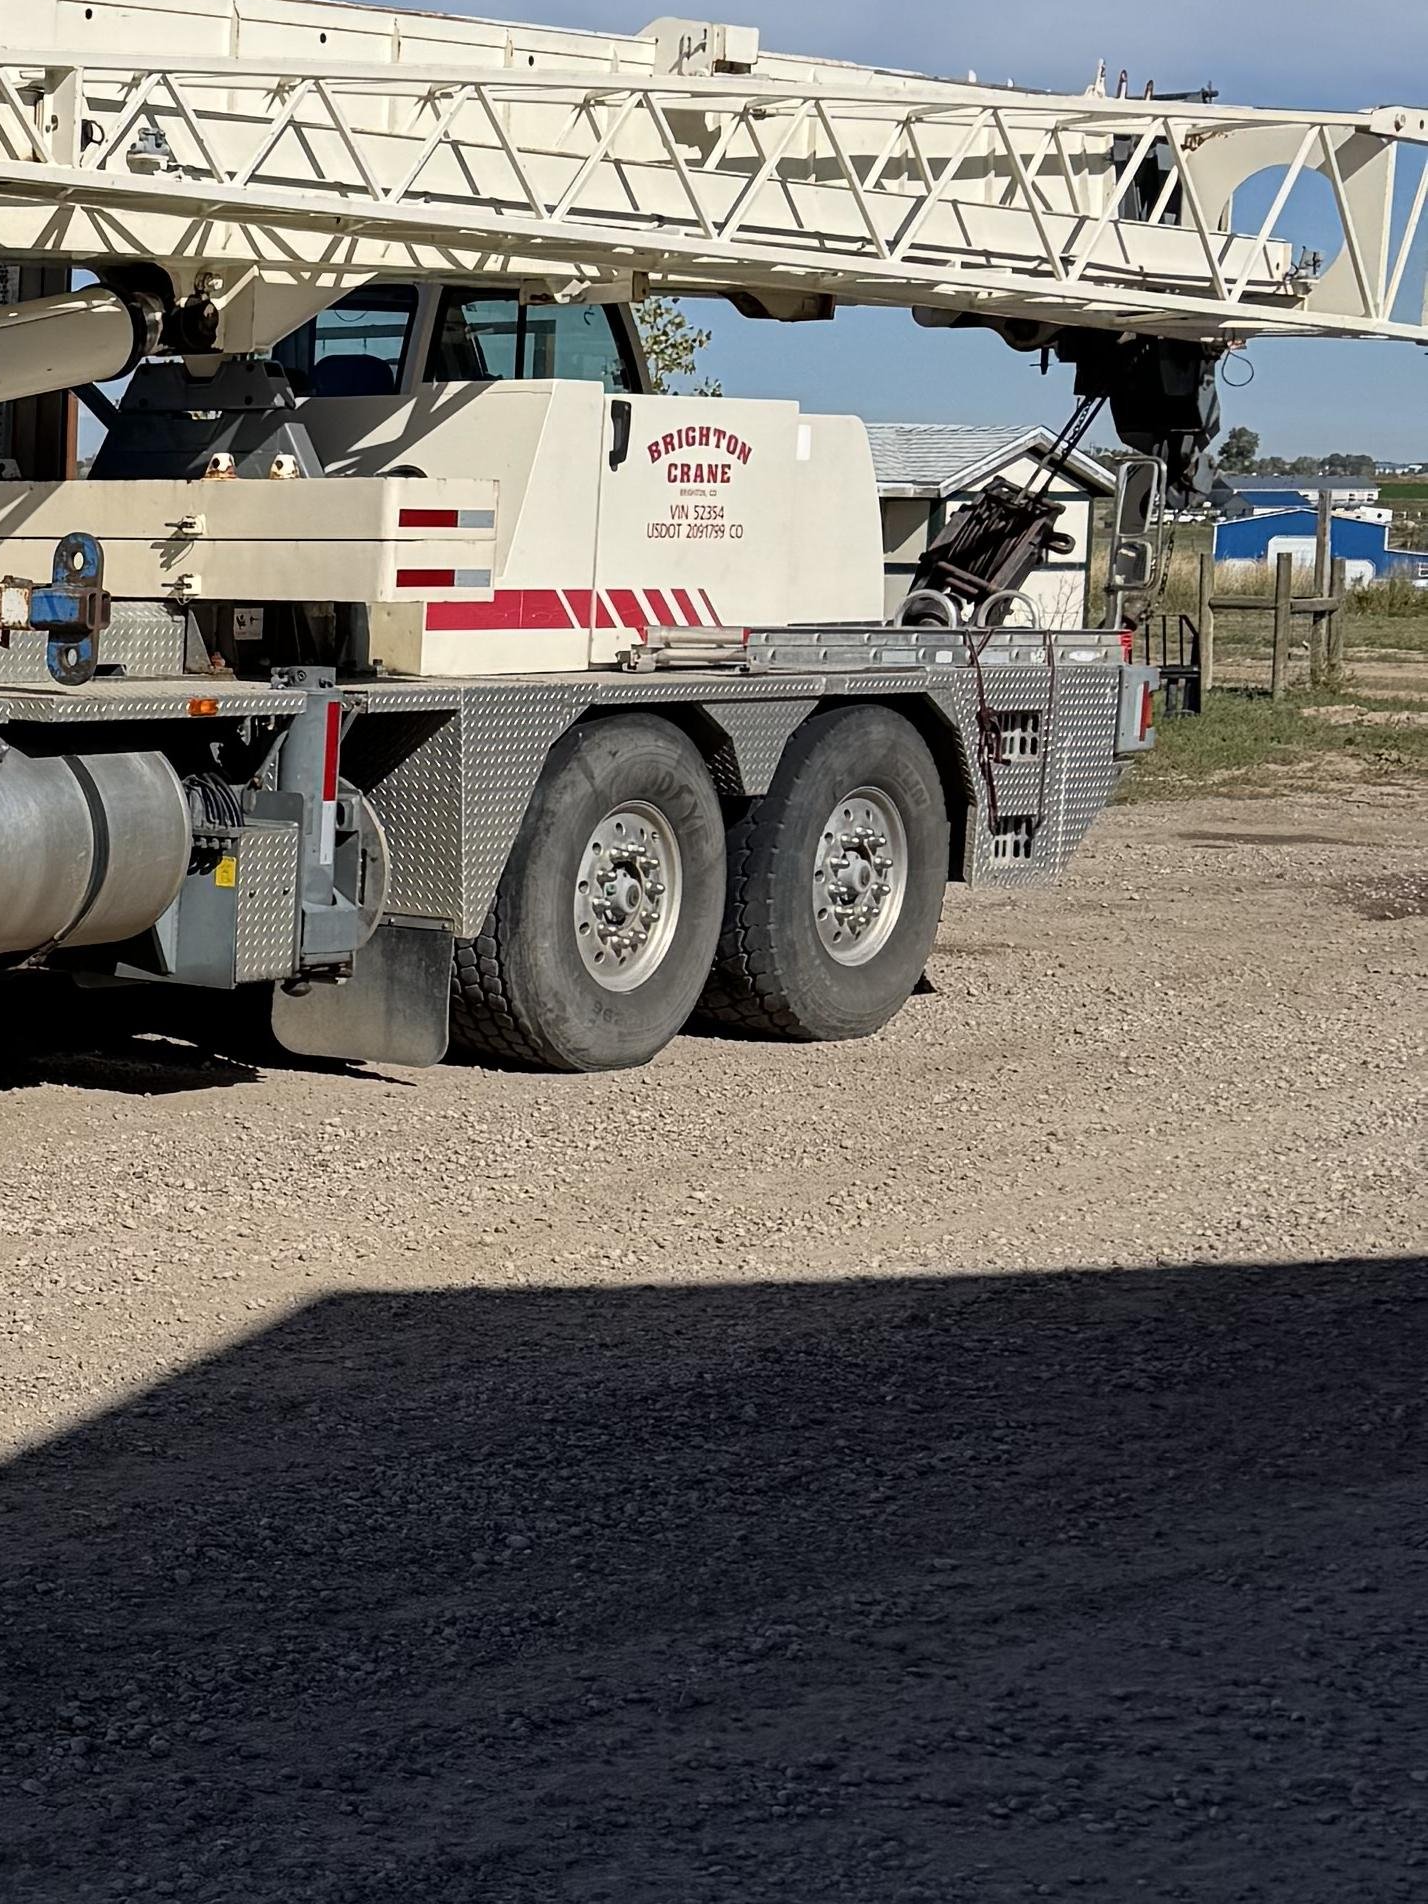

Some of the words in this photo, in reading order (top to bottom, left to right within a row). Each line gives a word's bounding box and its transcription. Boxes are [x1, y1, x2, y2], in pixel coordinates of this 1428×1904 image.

[646, 426, 753, 465] BRIGHTON
[667, 462, 732, 484] CRANE
[670, 504, 689, 520] VIN
[693, 504, 725, 521] 52354
[646, 522, 683, 539] USDOT
[729, 524, 744, 539] CO
